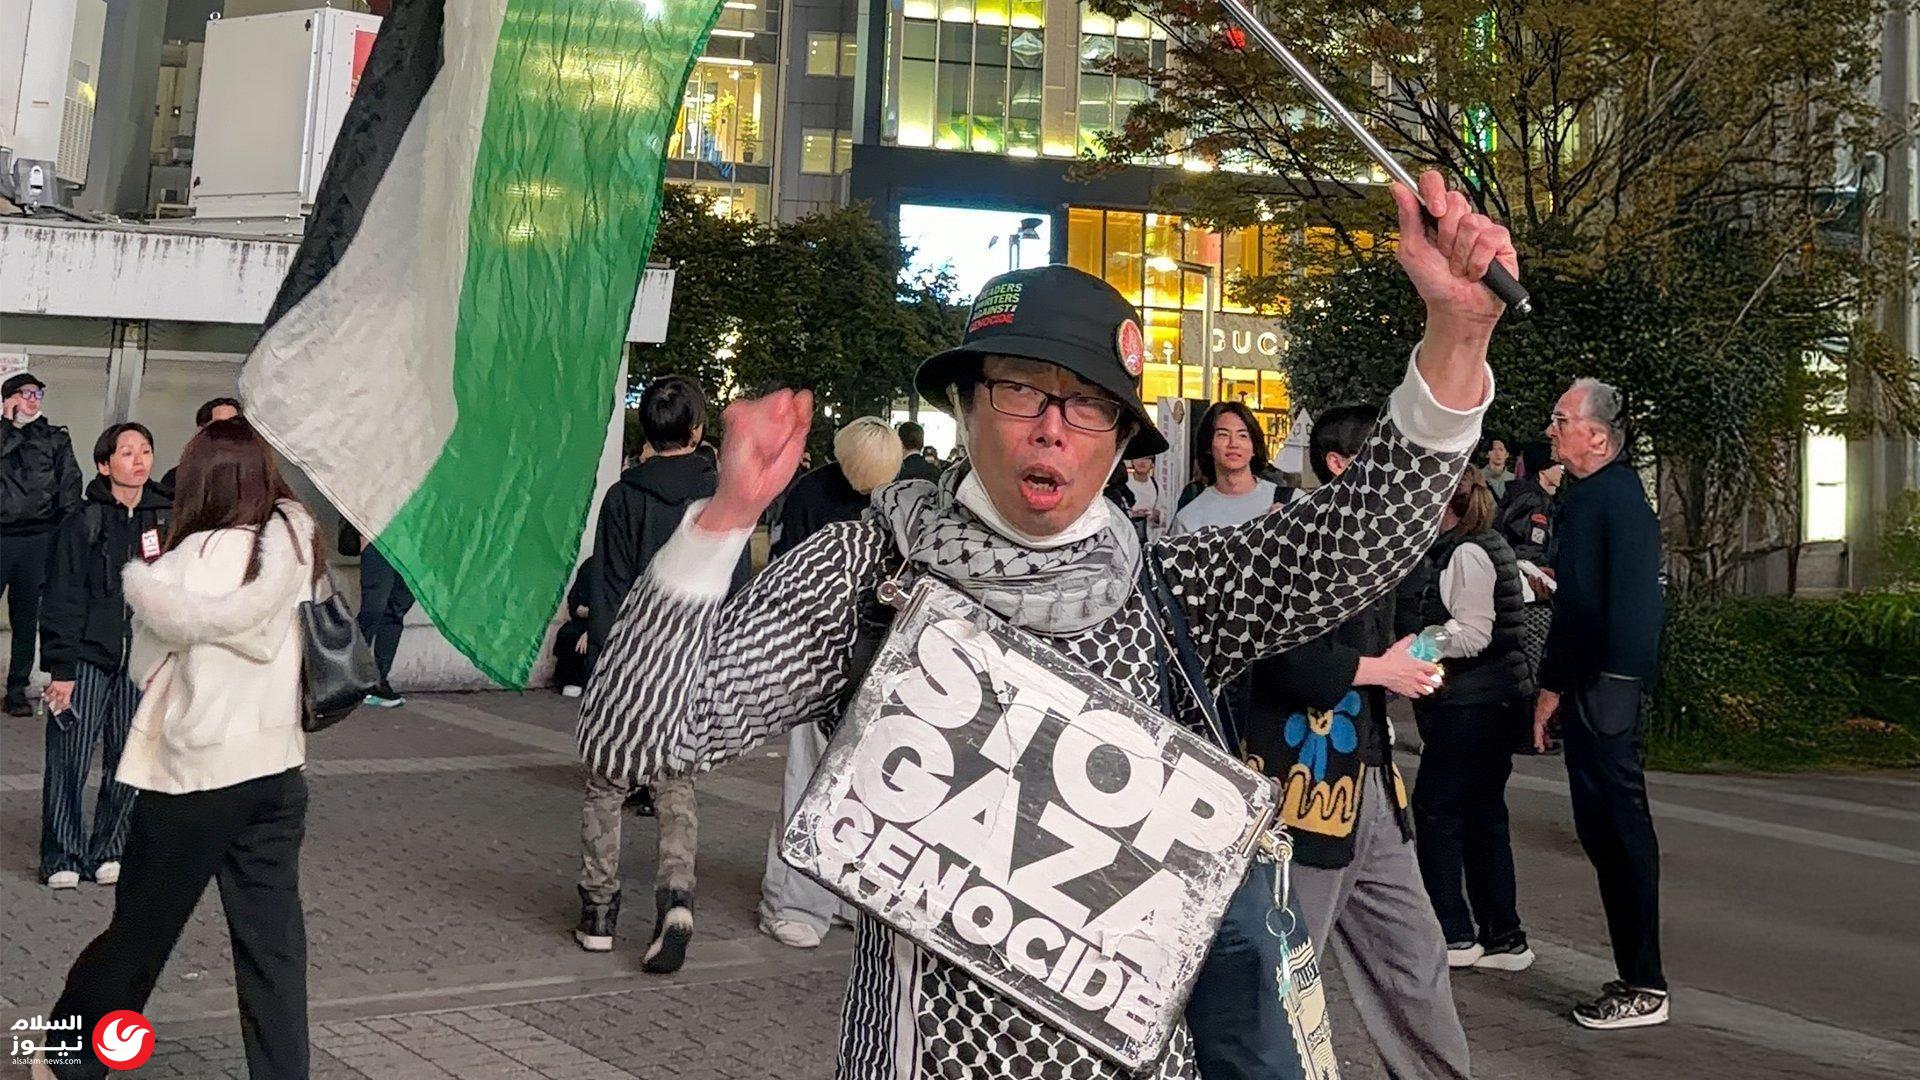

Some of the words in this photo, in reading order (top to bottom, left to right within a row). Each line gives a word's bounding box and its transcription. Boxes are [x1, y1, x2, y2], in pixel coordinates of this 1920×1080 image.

[969, 313, 1015, 333] GENOCIDE
[1212, 328, 1289, 356] GUC
[854, 714, 1190, 986] GAZA
[890, 619, 1248, 863] STOP
[818, 798, 1163, 1043] GENOCIDE
